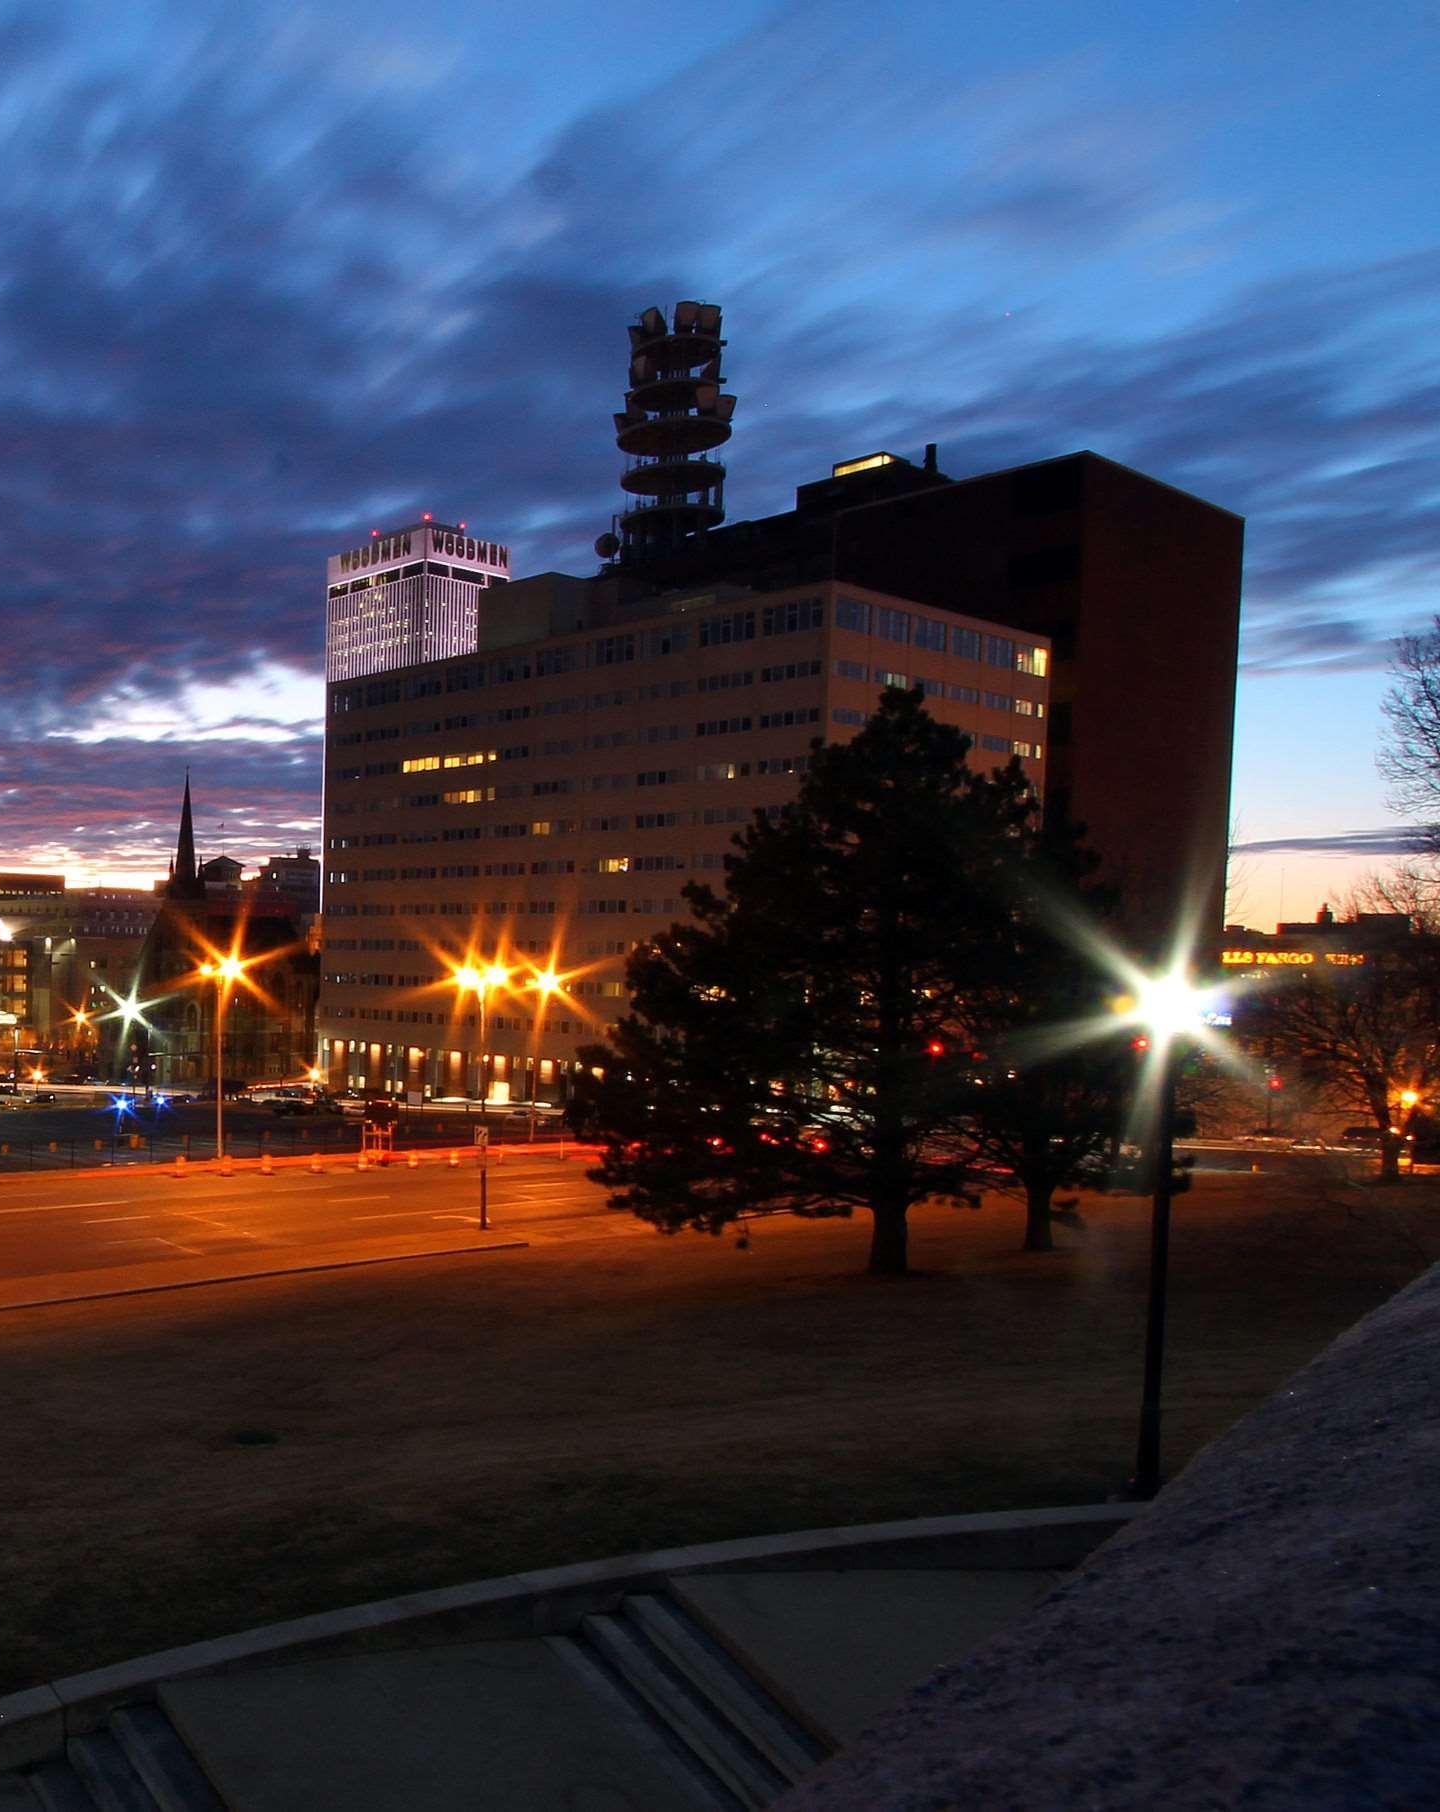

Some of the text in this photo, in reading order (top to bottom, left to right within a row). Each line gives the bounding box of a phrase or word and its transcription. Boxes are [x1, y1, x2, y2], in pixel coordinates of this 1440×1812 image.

[340, 534, 411, 573] WOODMEN
[432, 529, 508, 568] WOODMEN
[1221, 951, 1254, 964] LLS
[1256, 952, 1314, 964] FARGO
